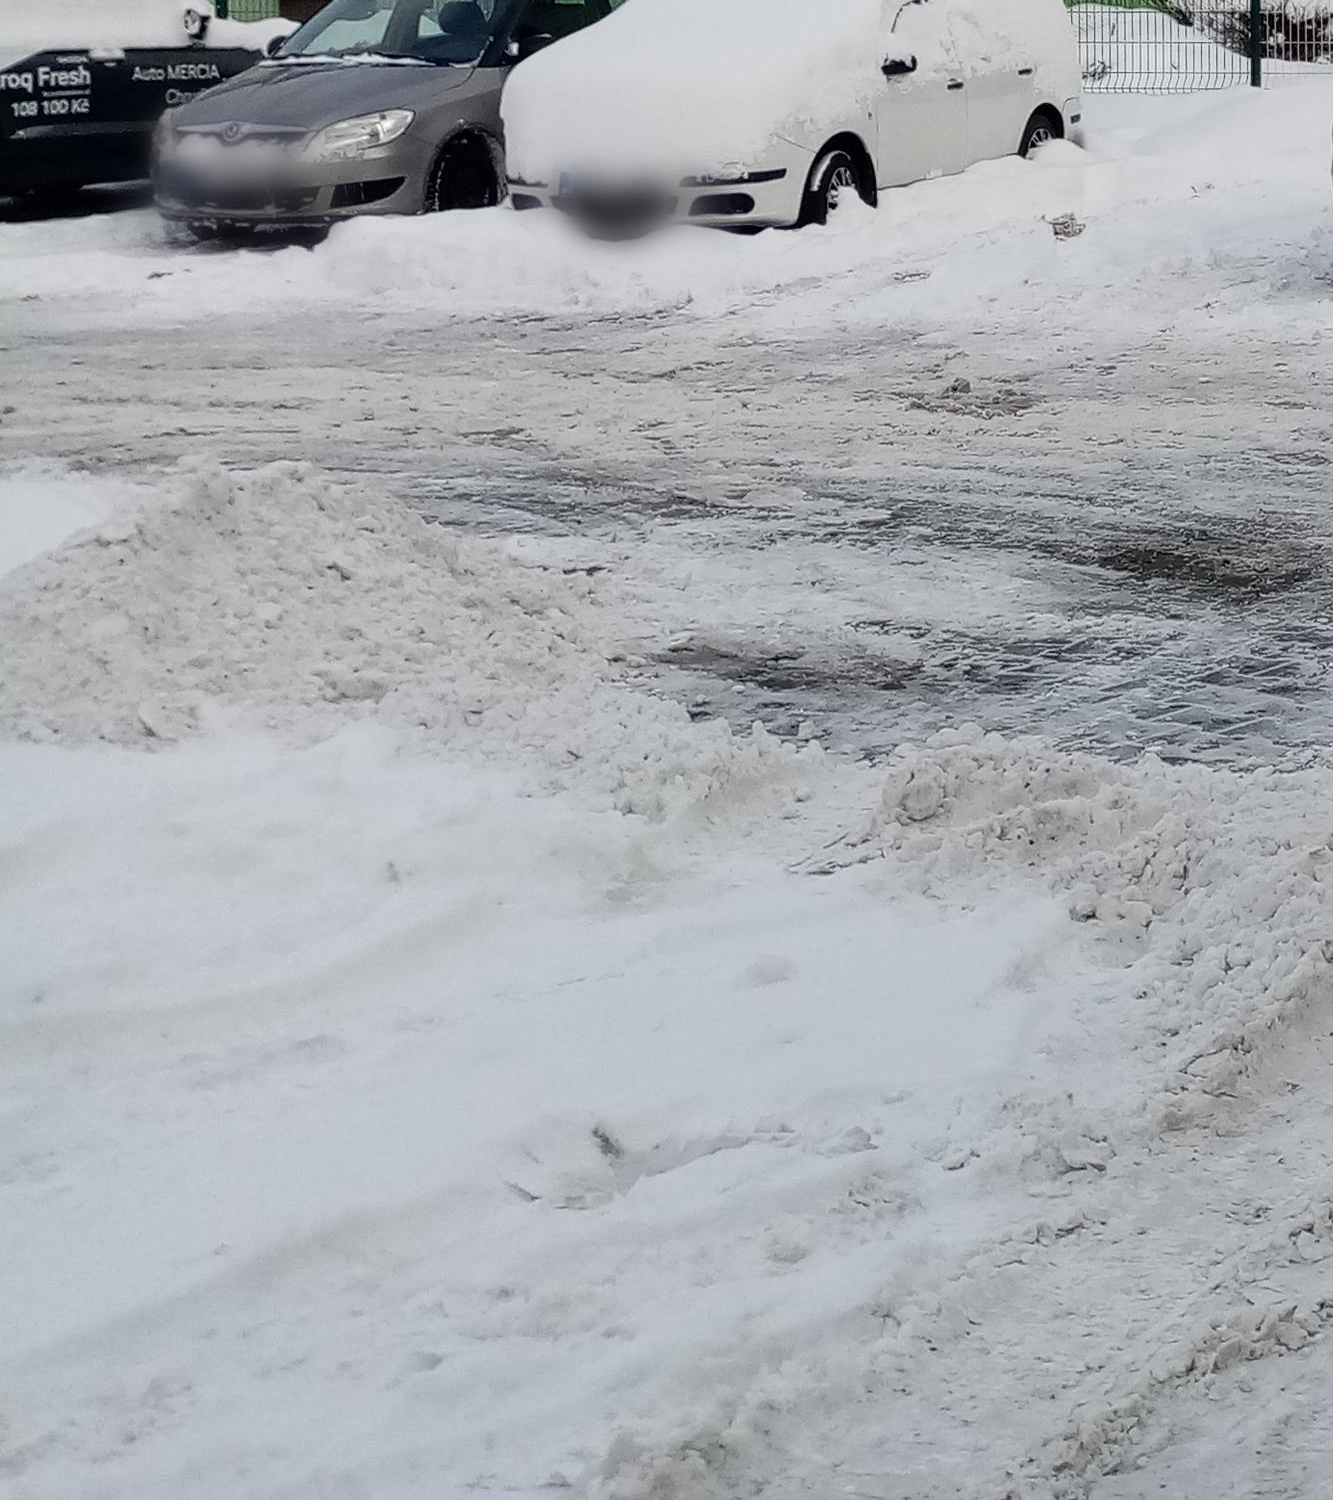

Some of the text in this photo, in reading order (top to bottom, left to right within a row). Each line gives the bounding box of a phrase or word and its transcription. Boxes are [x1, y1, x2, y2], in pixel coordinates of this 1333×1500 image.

[37, 65, 91, 87] Fresh
[131, 63, 220, 81] Auto MERCIA
[41, 99, 69, 115] 100
